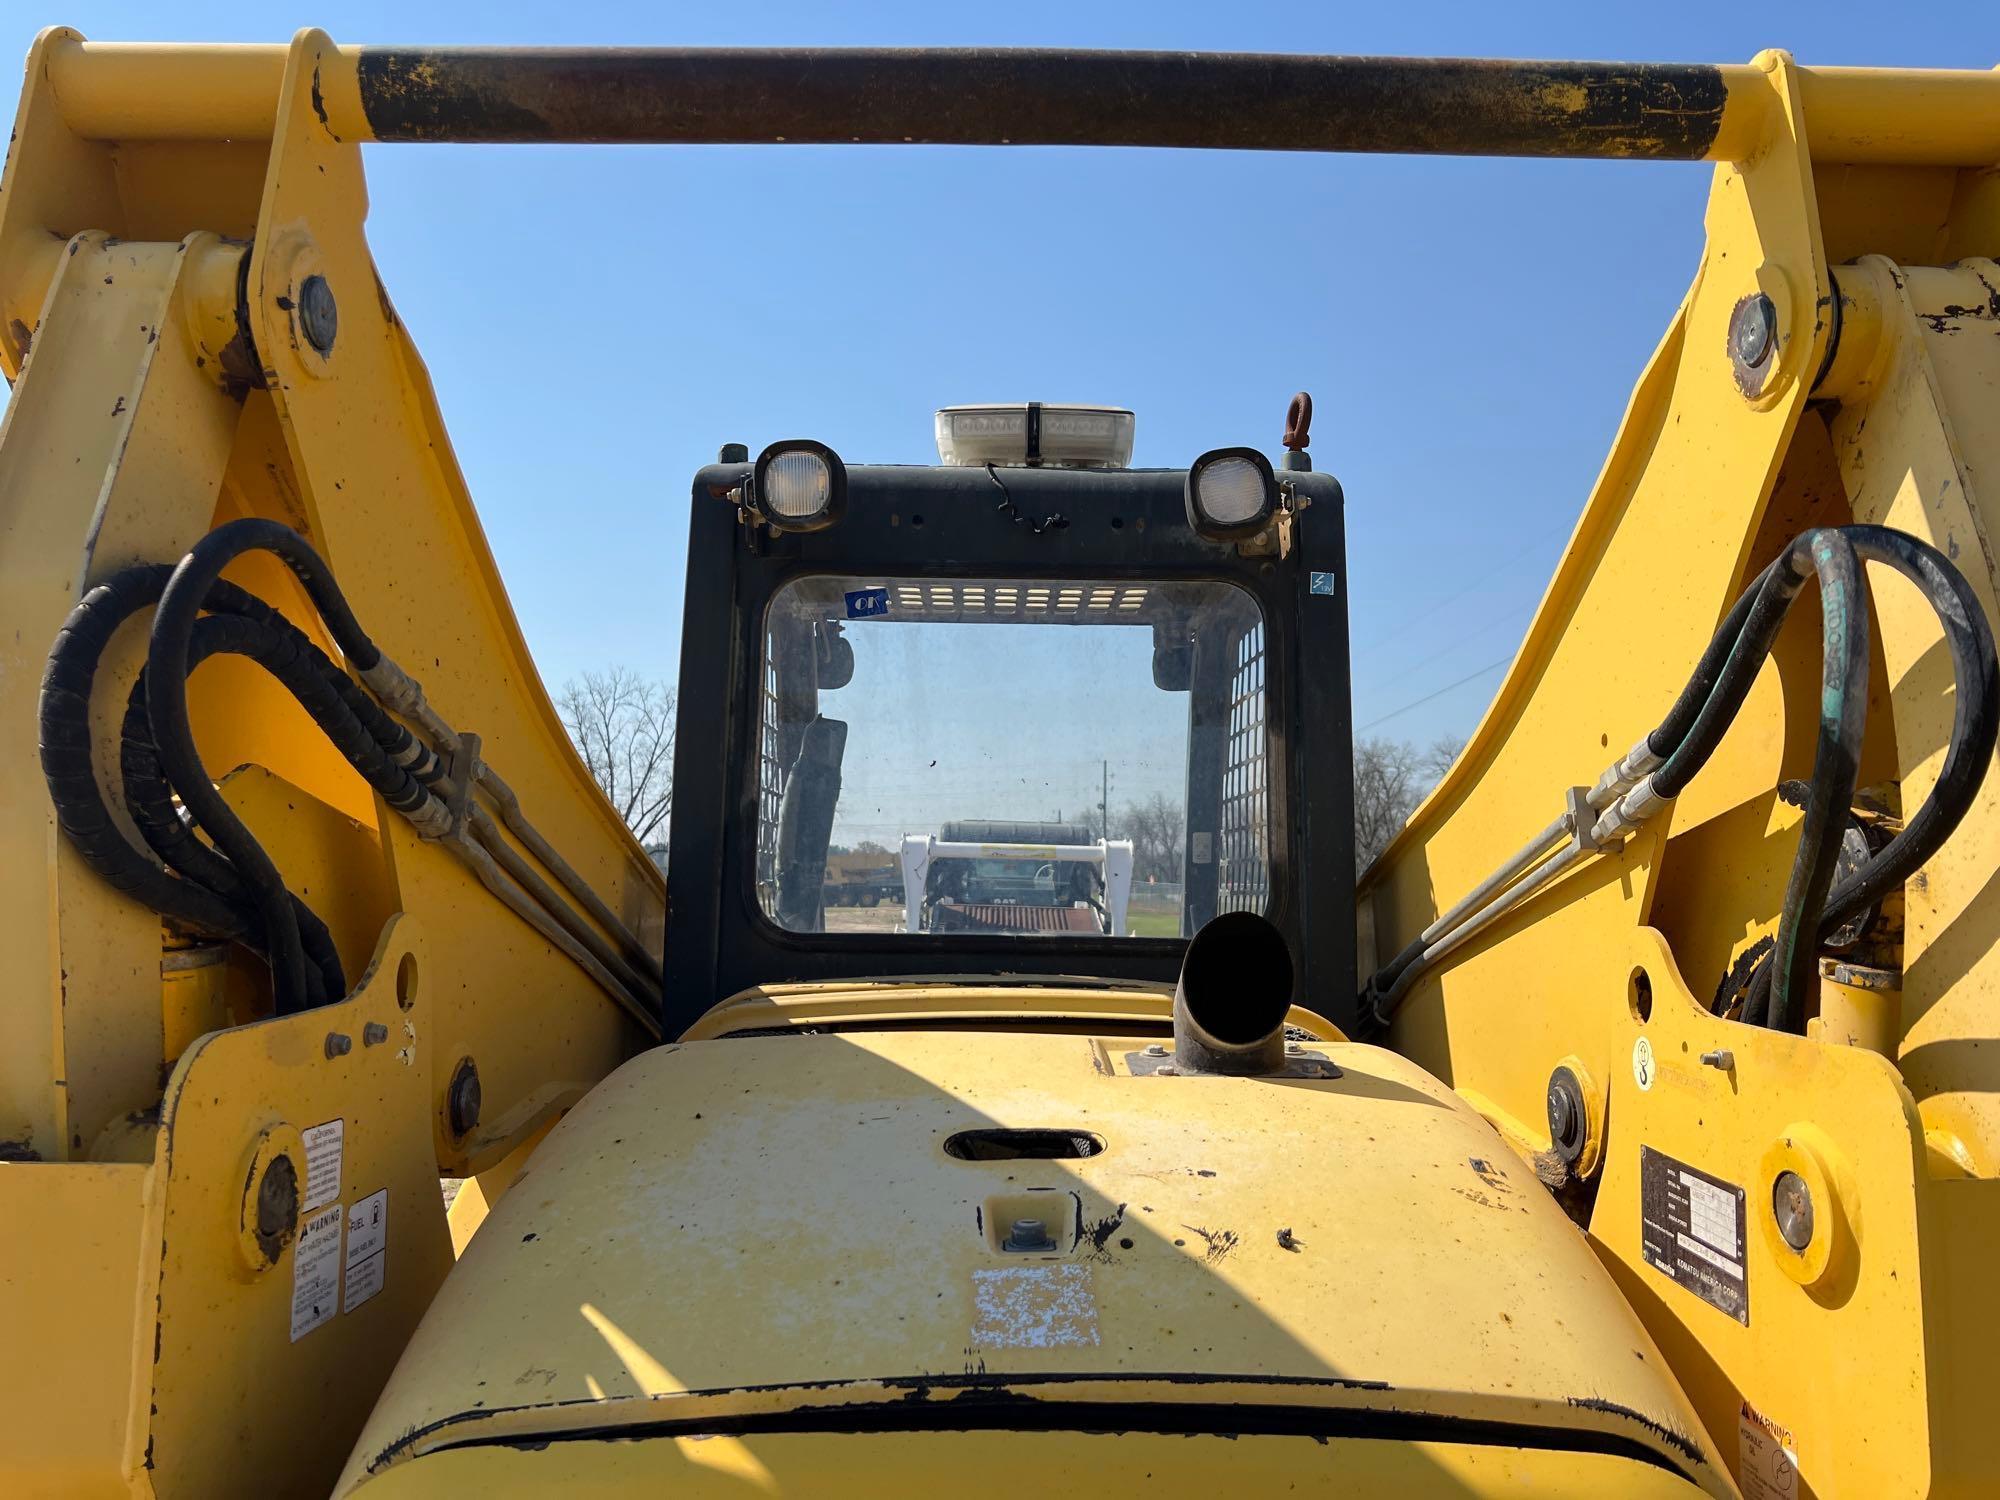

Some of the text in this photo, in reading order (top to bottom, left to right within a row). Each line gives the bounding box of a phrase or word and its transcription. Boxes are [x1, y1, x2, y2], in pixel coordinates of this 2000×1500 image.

[855, 596, 880, 610] OK
[310, 1209, 340, 1232] WARNING
[350, 1217, 365, 1233] FUEL
[1677, 1258, 1700, 1278] KOMATSU
[1752, 1411, 1792, 1446] WARNING
